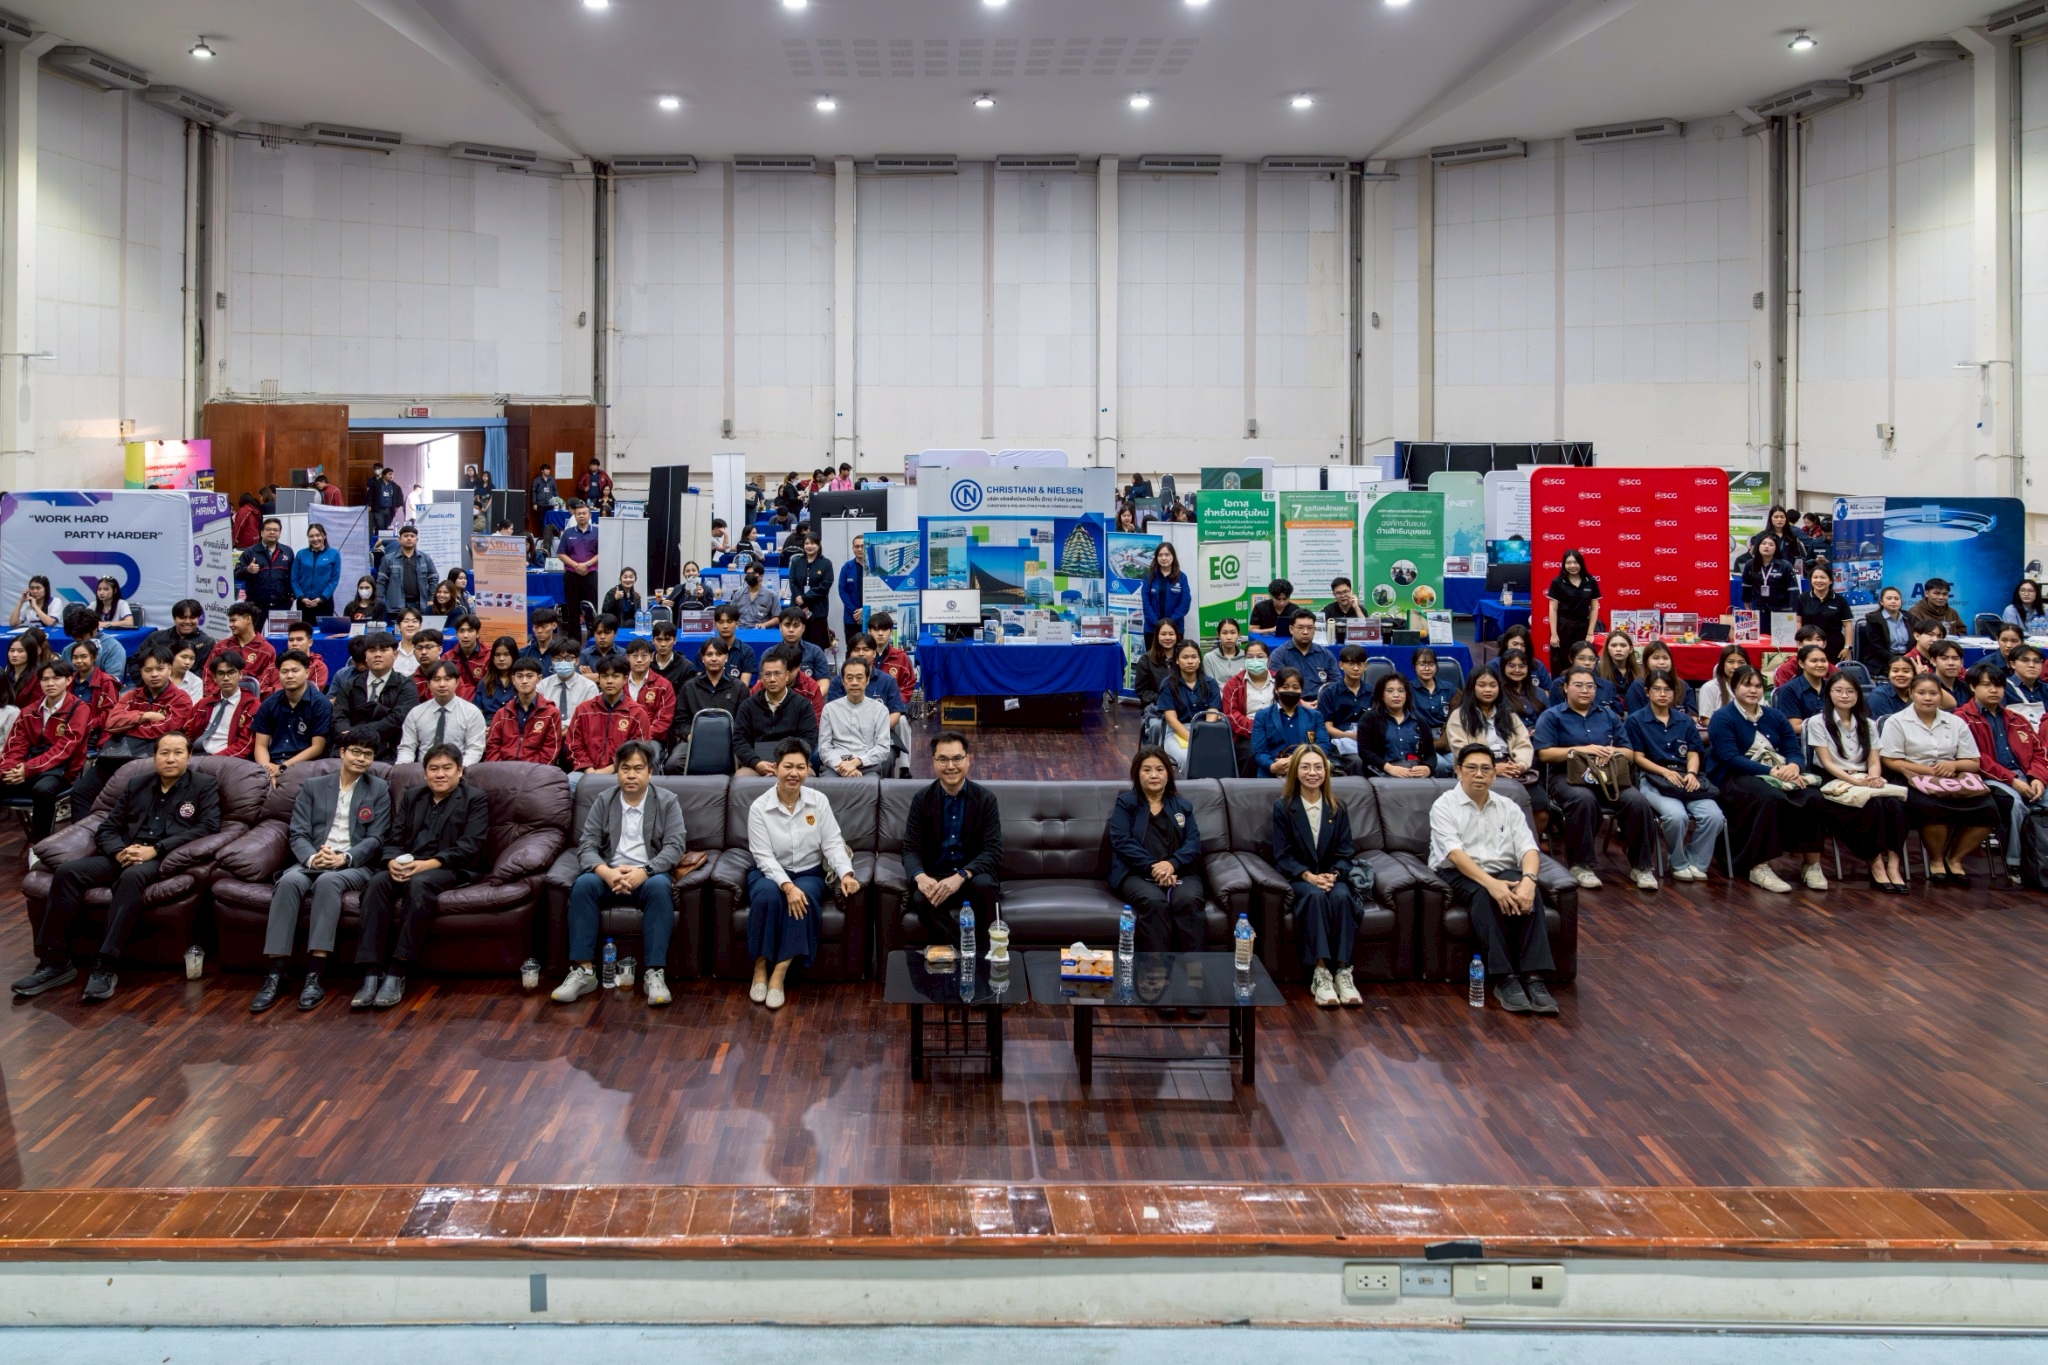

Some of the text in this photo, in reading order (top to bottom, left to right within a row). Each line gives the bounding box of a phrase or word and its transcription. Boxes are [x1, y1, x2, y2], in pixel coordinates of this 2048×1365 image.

[986, 486, 1083, 495] CHRISTIANI & NIELSEN
[1223, 499, 1249, 507] โอกาส
[195, 506, 217, 516] HIRING
[1204, 508, 1269, 519] สำหรับคนรุ่นใหม่
[1291, 504, 1302, 518] 7
[74, 515, 109, 523] HARD
[1381, 519, 1426, 527] องค์กรต้นแบบ
[64, 530, 105, 539] PARTY
